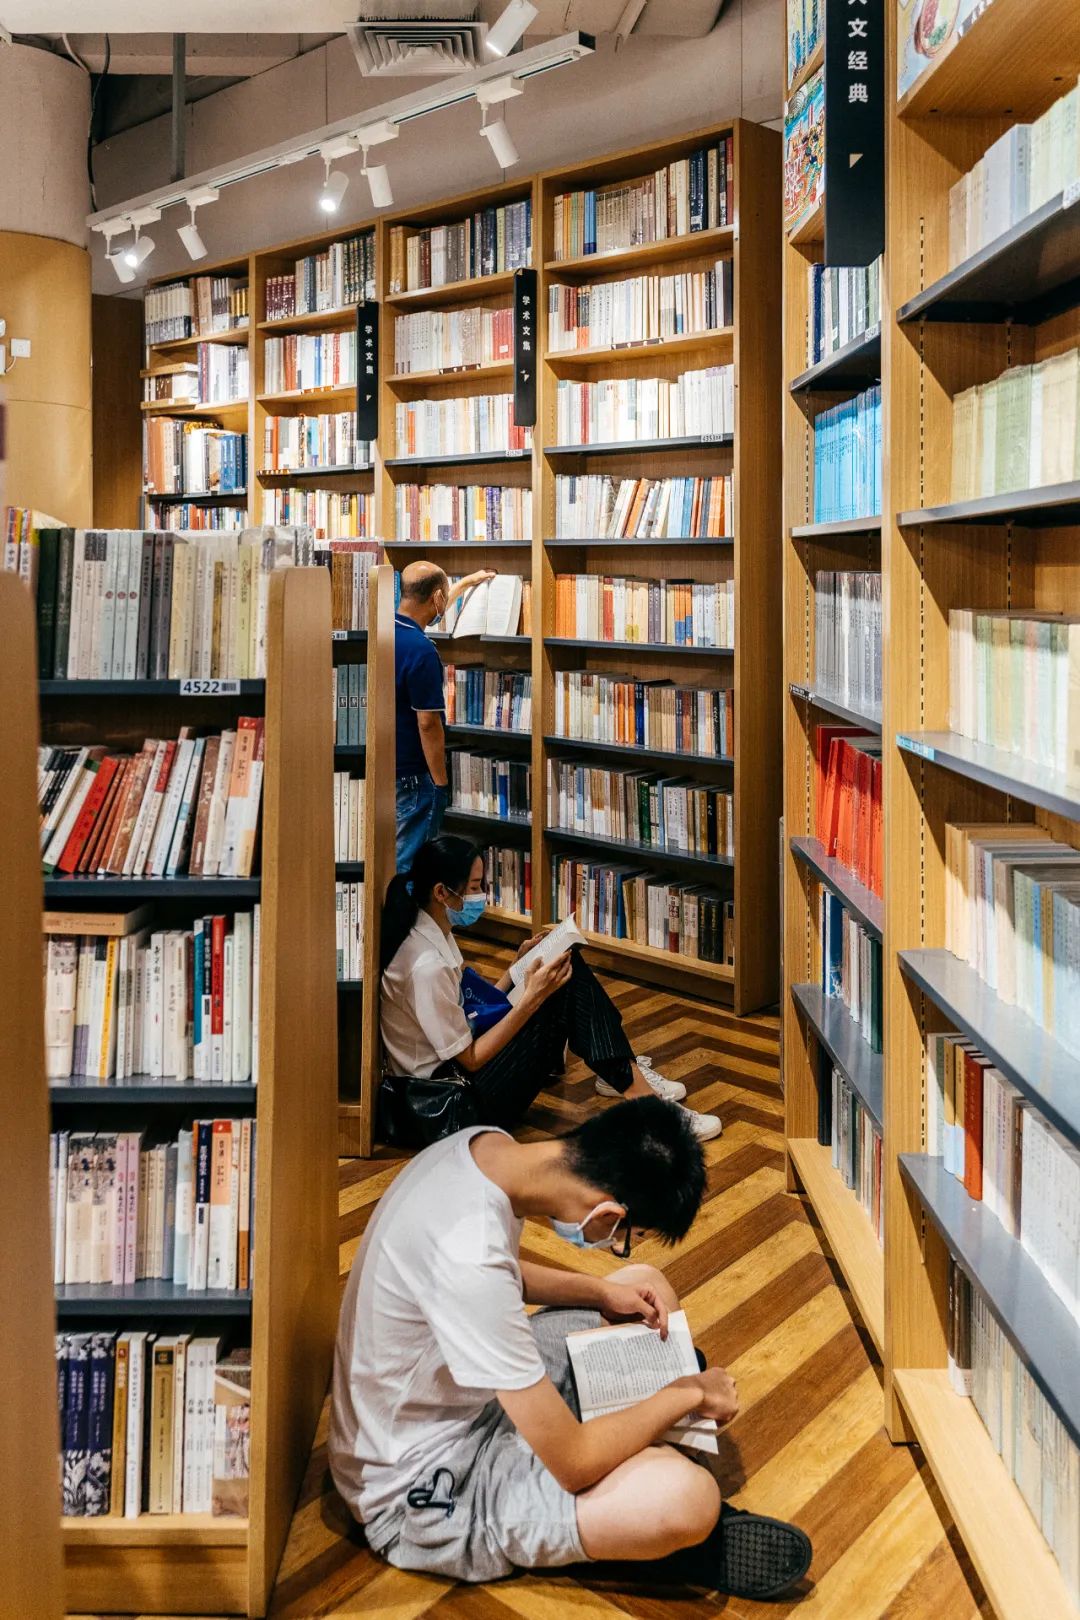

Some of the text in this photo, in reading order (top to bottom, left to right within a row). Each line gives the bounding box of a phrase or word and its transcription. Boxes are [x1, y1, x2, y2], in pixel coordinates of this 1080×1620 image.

[522, 295, 531, 351] 学术文集
[365, 325, 374, 374] 学术文集
[183, 681, 220, 693] 4522
